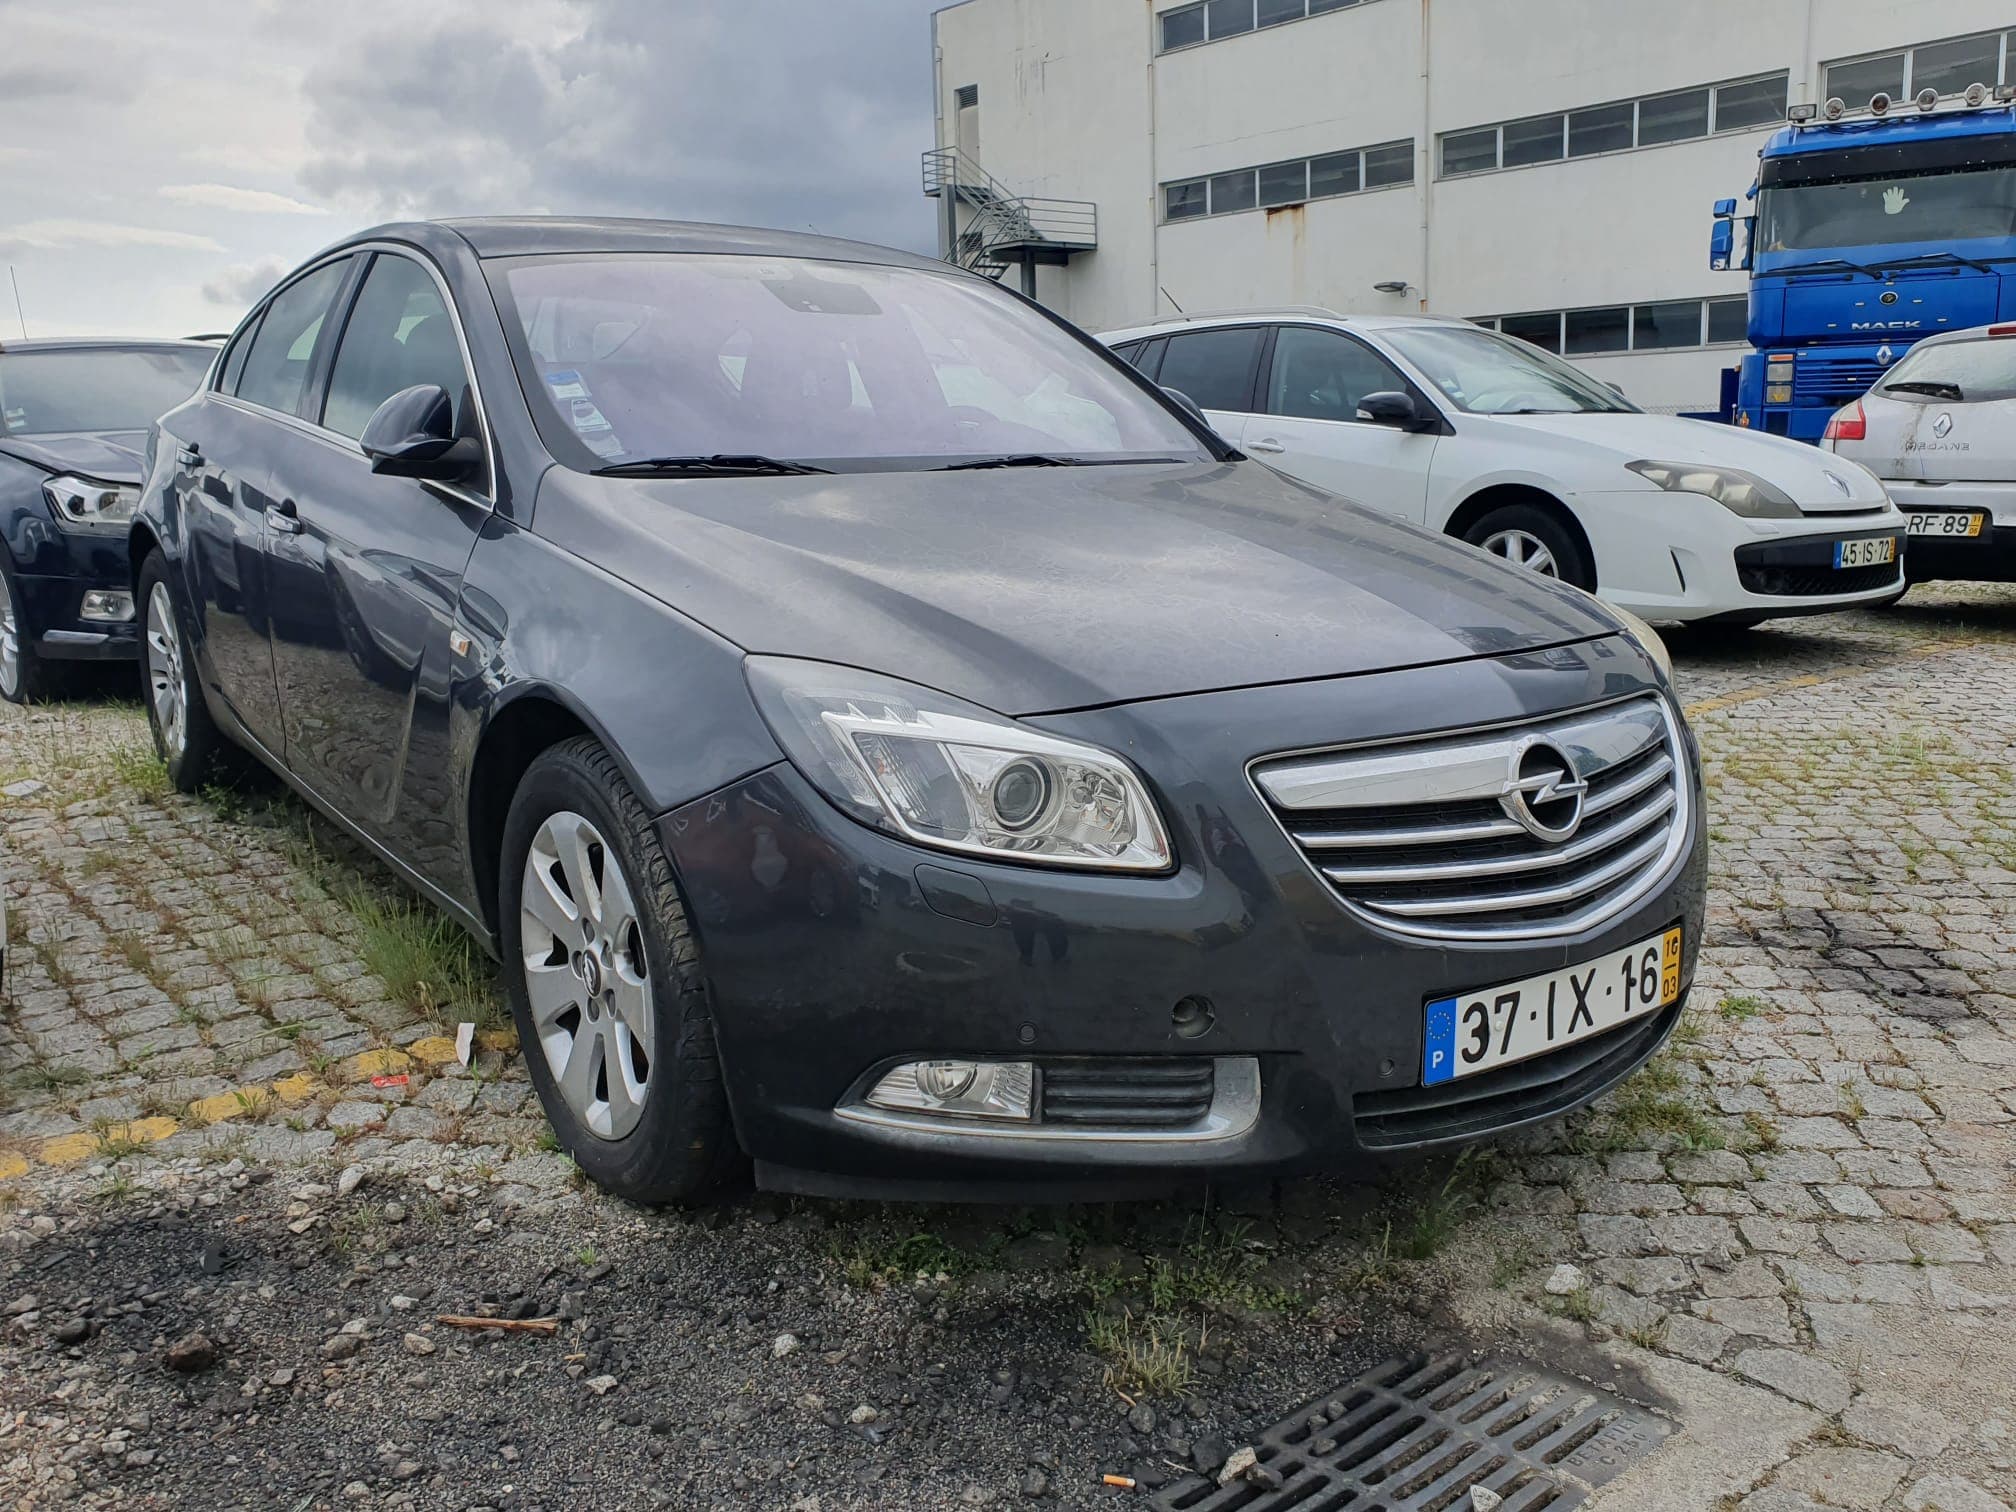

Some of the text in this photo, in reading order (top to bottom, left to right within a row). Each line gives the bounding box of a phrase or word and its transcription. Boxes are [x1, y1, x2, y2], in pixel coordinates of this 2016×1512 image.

[1851, 320, 1921, 330] MACK
[1663, 976, 1677, 998] 03
[1432, 1050, 1444, 1069] P
[1599, 1432, 1647, 1466] C 250
